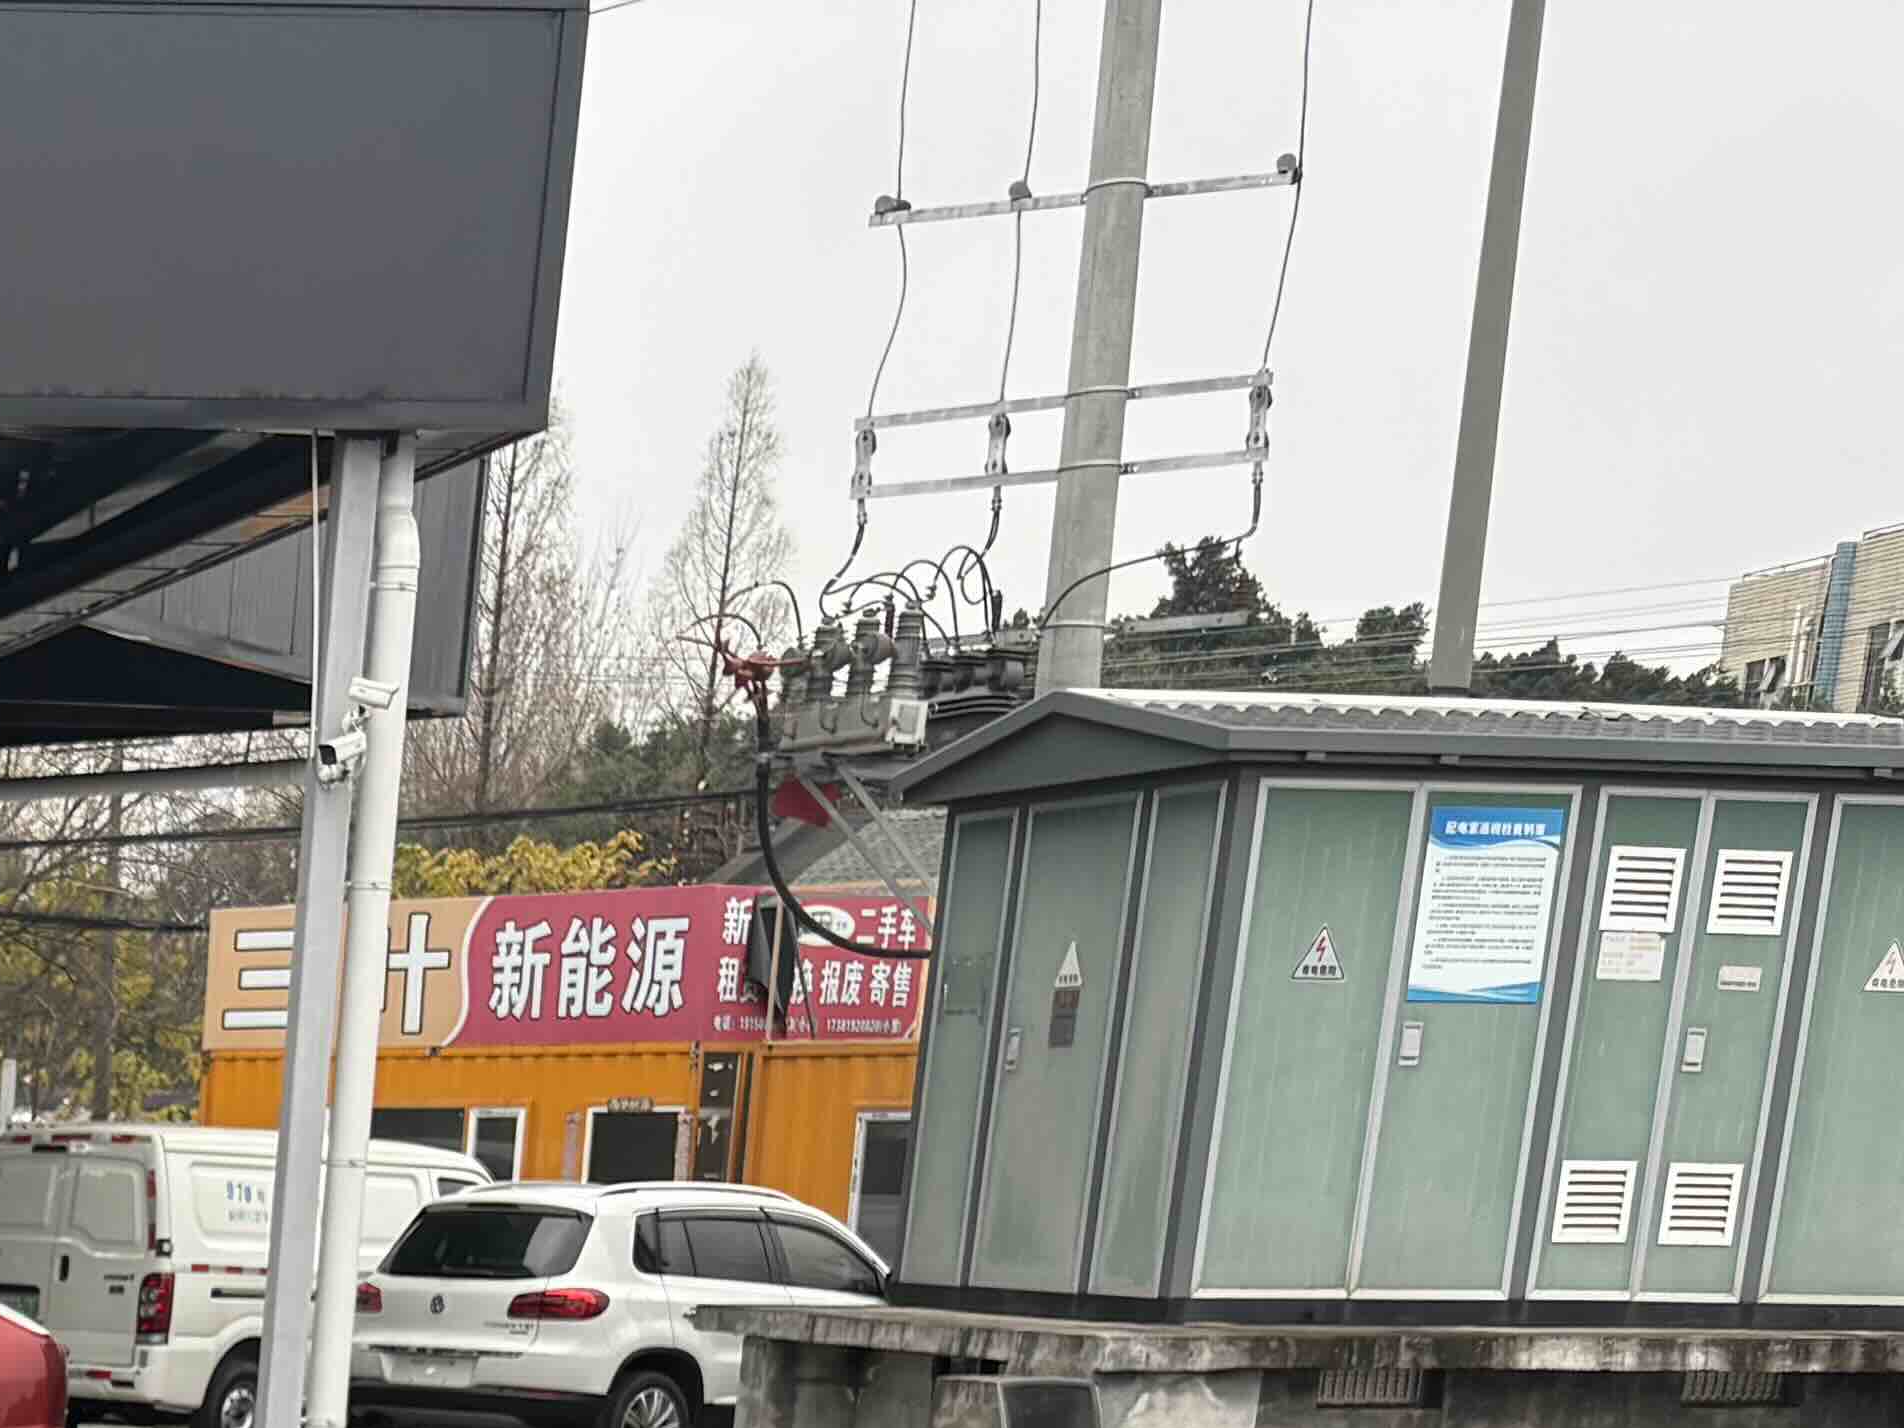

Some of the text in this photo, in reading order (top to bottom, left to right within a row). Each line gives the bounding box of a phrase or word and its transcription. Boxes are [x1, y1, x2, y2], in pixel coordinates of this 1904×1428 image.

[856, 904, 917, 951] 二手车
[489, 916, 691, 1021] 新能源
